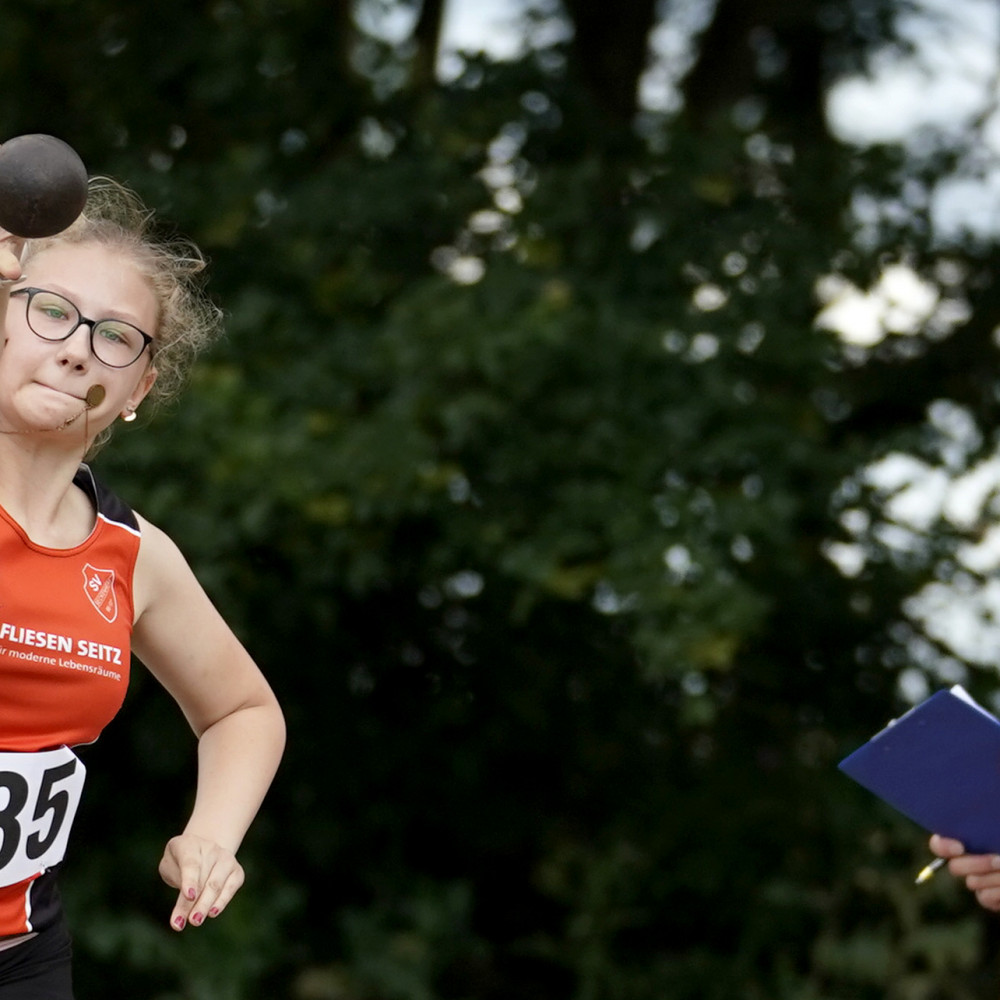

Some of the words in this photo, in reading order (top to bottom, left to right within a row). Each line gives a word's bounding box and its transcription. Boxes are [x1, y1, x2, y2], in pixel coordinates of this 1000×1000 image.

[89, 574, 102, 592] SV
[0, 623, 73, 652] FLIESEN
[77, 640, 122, 665] SEITZ
[8, 649, 57, 665] moderne
[58, 658, 121, 681] Lebensräume
